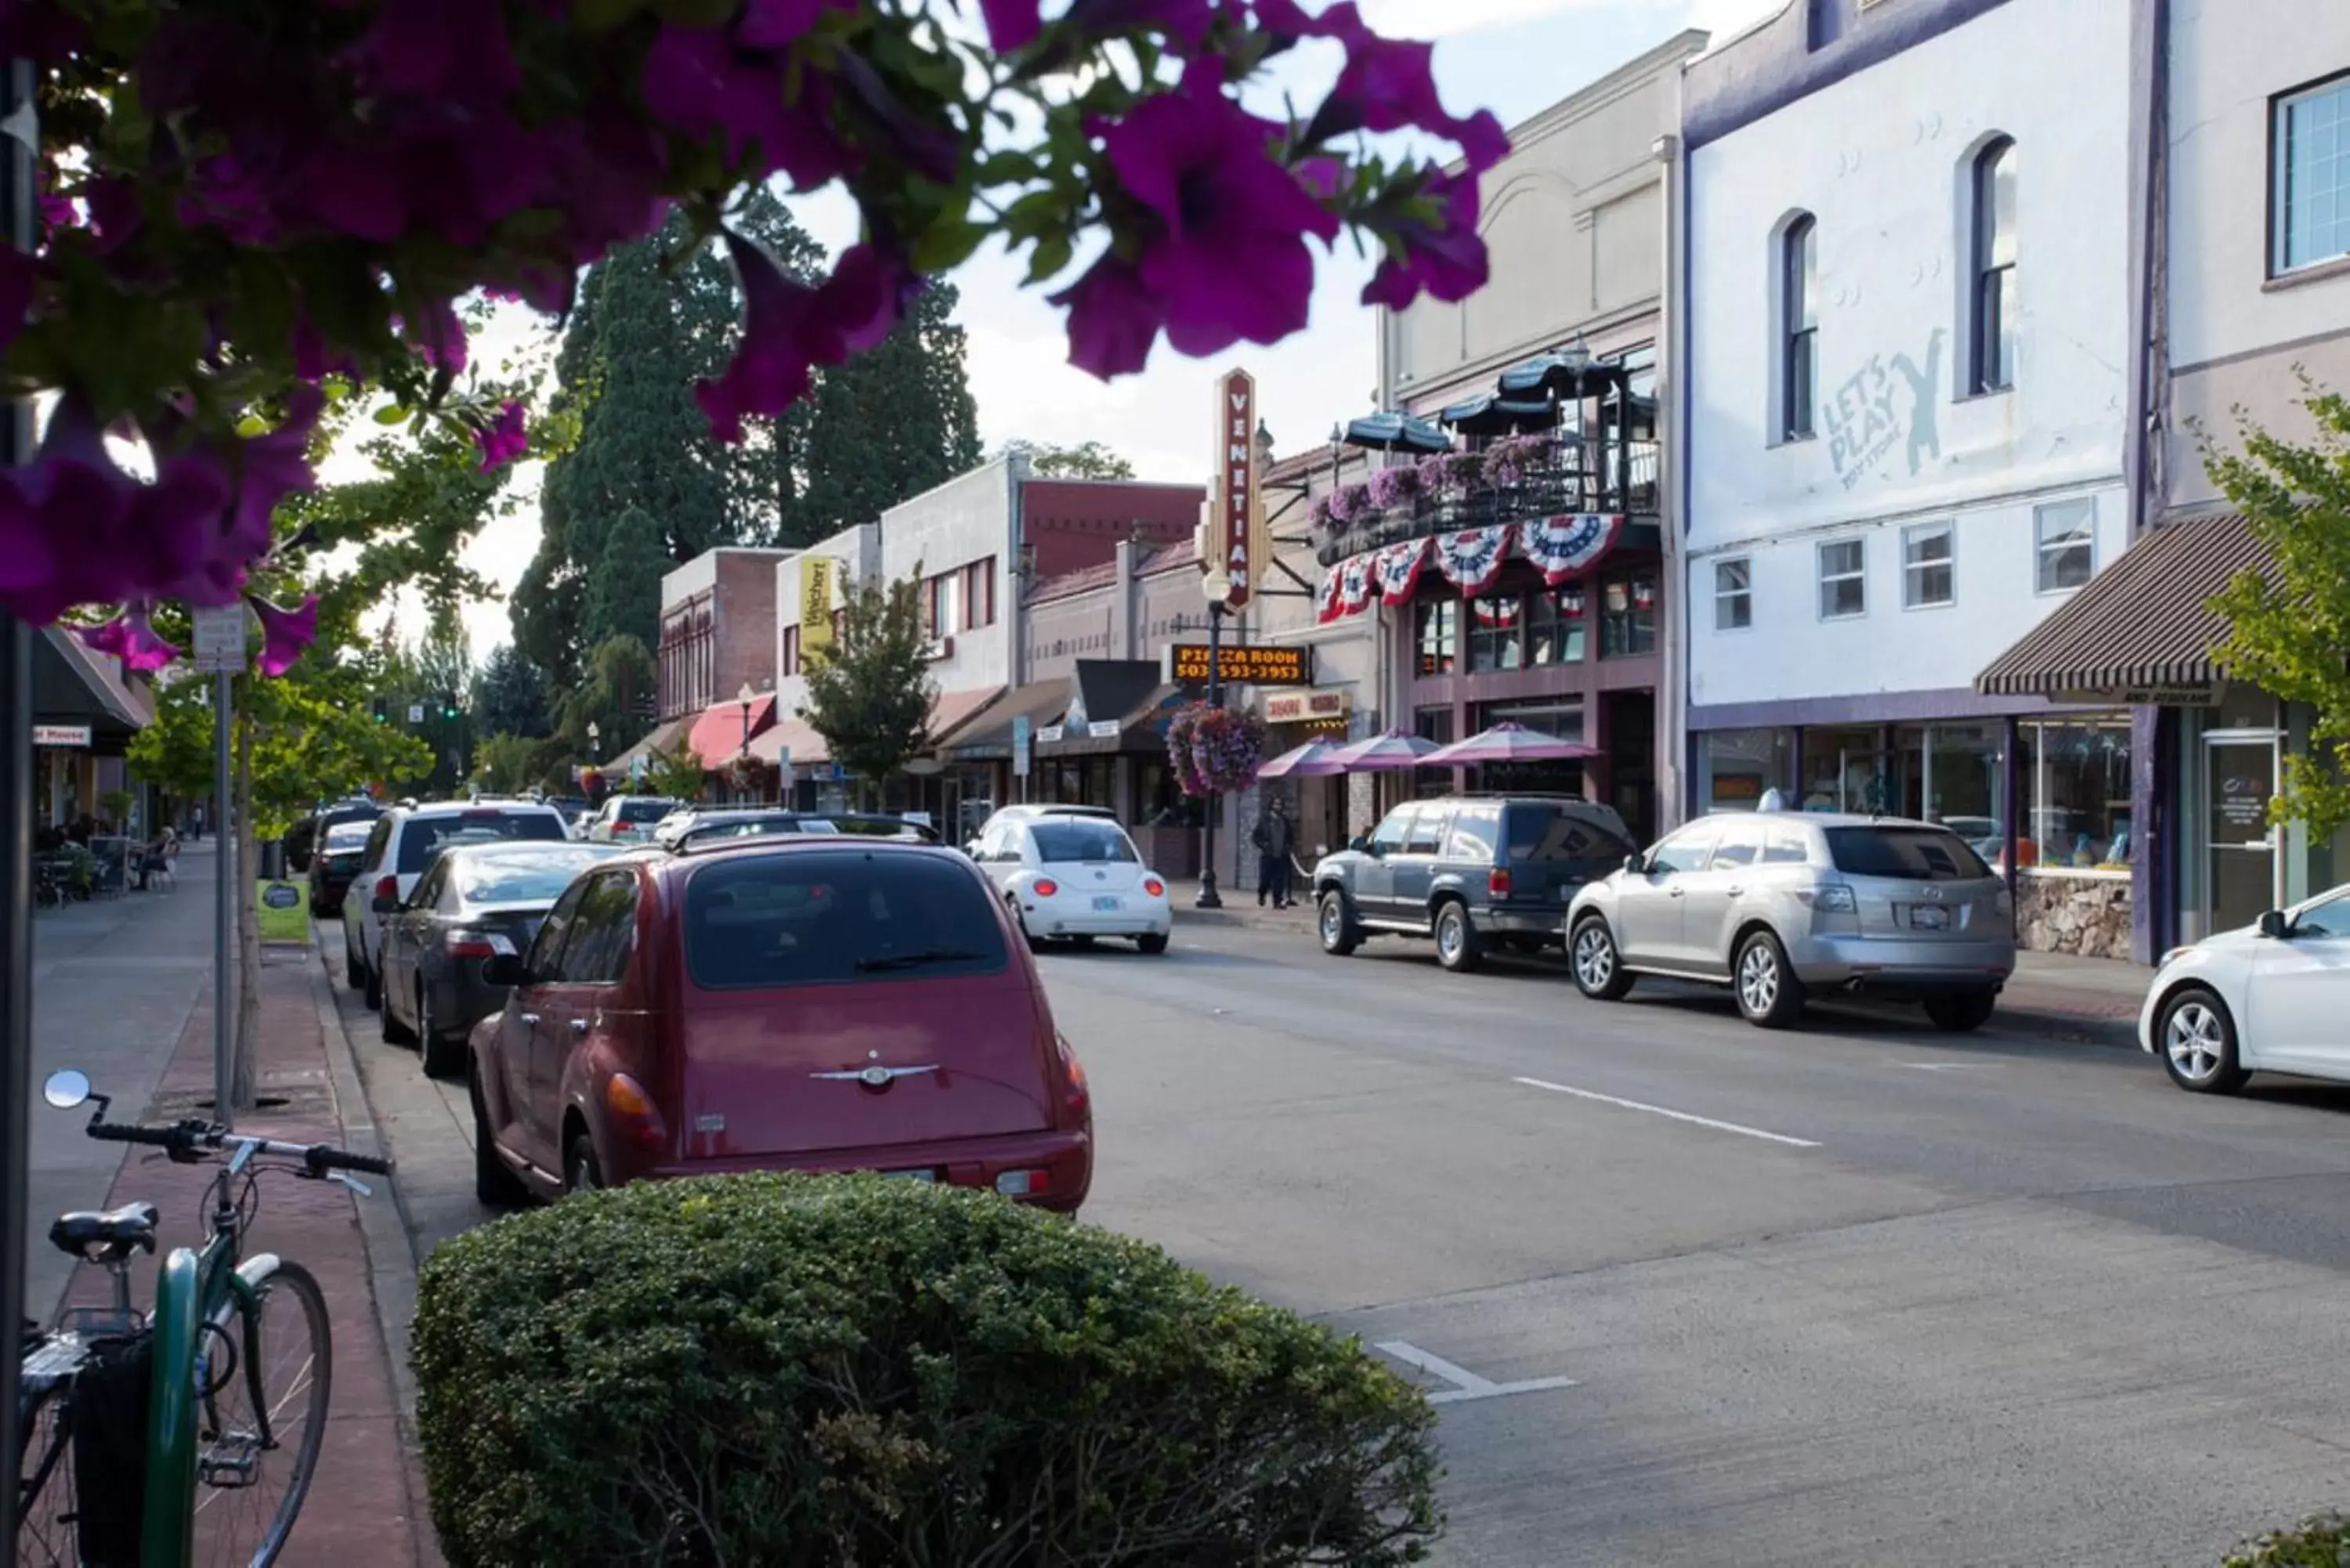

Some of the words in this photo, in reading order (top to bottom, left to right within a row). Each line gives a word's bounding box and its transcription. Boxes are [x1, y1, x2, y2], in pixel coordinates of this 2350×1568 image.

[1829, 383, 1896, 474] PLAY
[1230, 393, 1248, 587] VENETIAN
[1177, 664, 1299, 679] 503593-3953
[1251, 650, 1298, 663] ROOM
